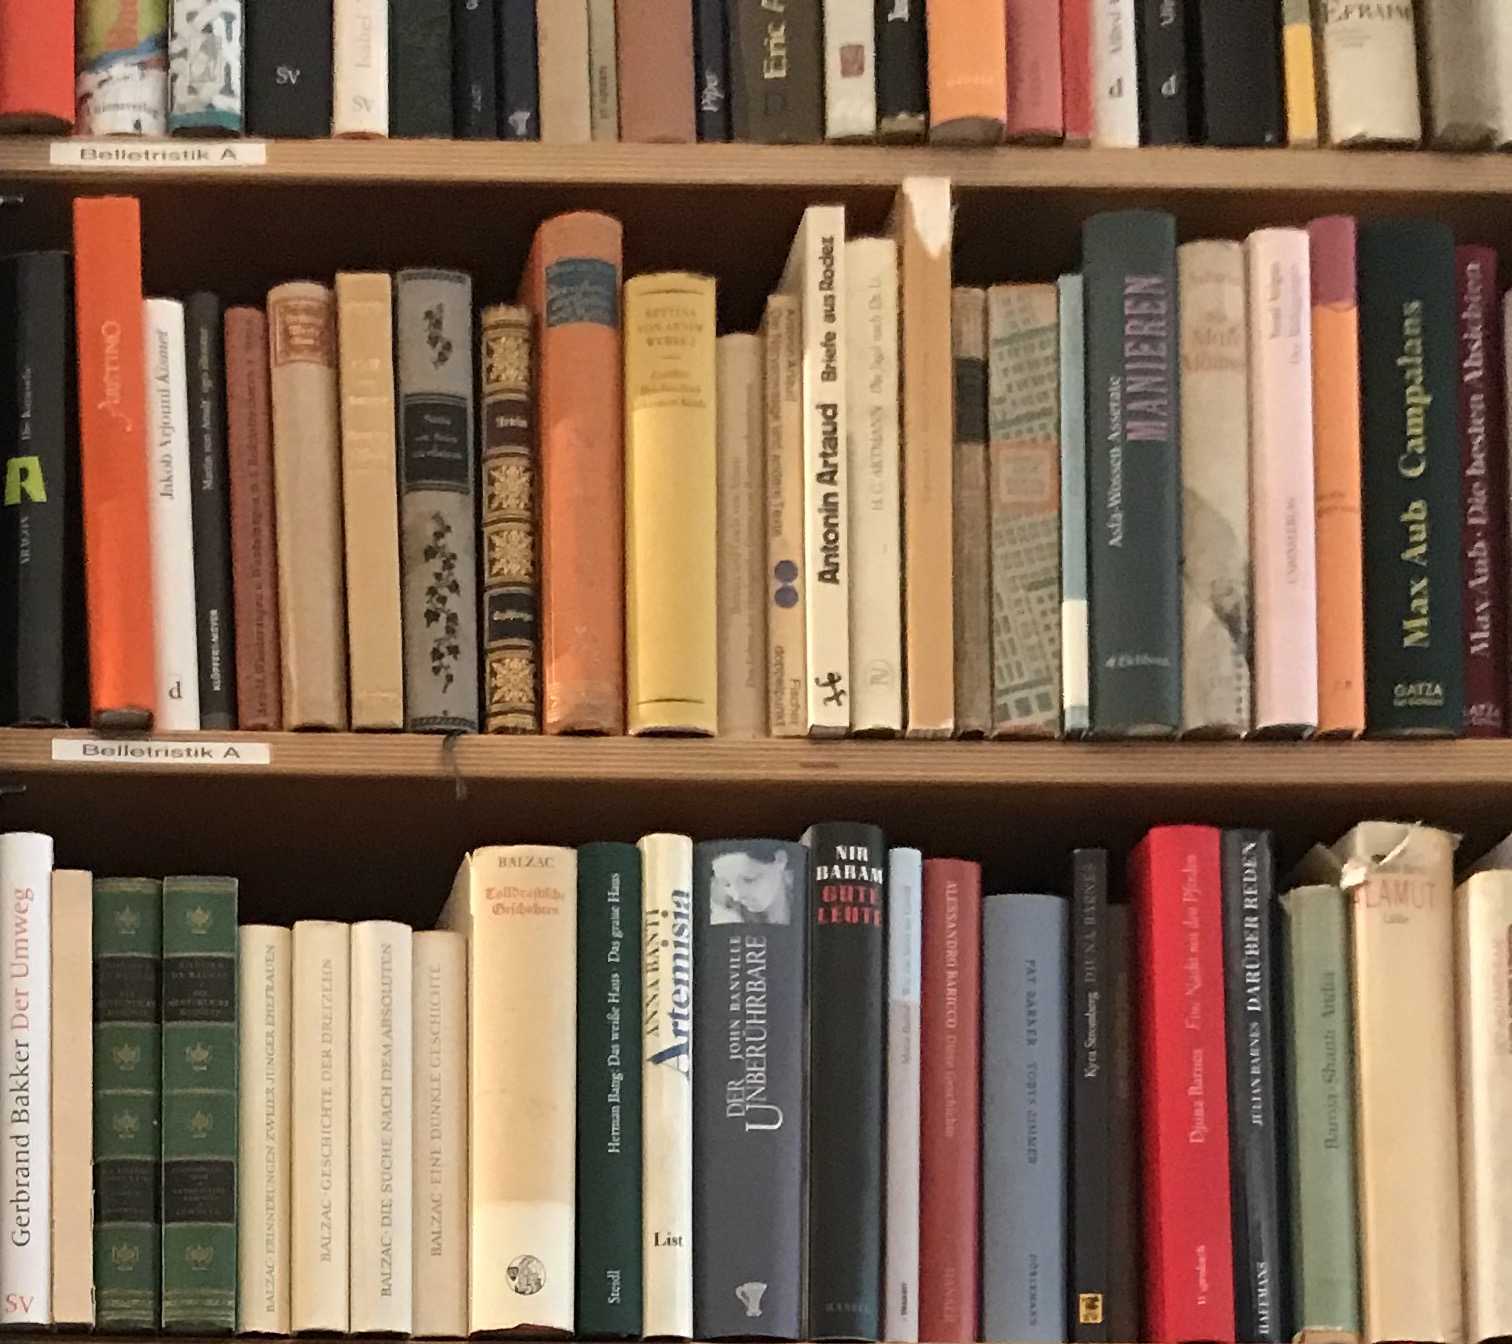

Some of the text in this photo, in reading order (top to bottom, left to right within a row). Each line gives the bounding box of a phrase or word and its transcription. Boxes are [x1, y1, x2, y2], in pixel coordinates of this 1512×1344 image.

[79, 147, 236, 160] Belletristik A
[815, 236, 840, 585] Antonin Artaud Briefe aus Rodez
[1125, 275, 1168, 441] MANIEREN
[1397, 300, 1432, 649] Max Aub Campalans
[82, 744, 240, 758] Belletristik A
[10, 888, 33, 1247] Gerbrand Bakker Der Umweg
[646, 890, 690, 1080] Artemisia
[729, 936, 741, 1059] JOHN BANVILLE
[742, 936, 783, 1132] UNBERÜHRBARE
[726, 1080, 746, 1118] DER
[654, 1232, 683, 1247] List
